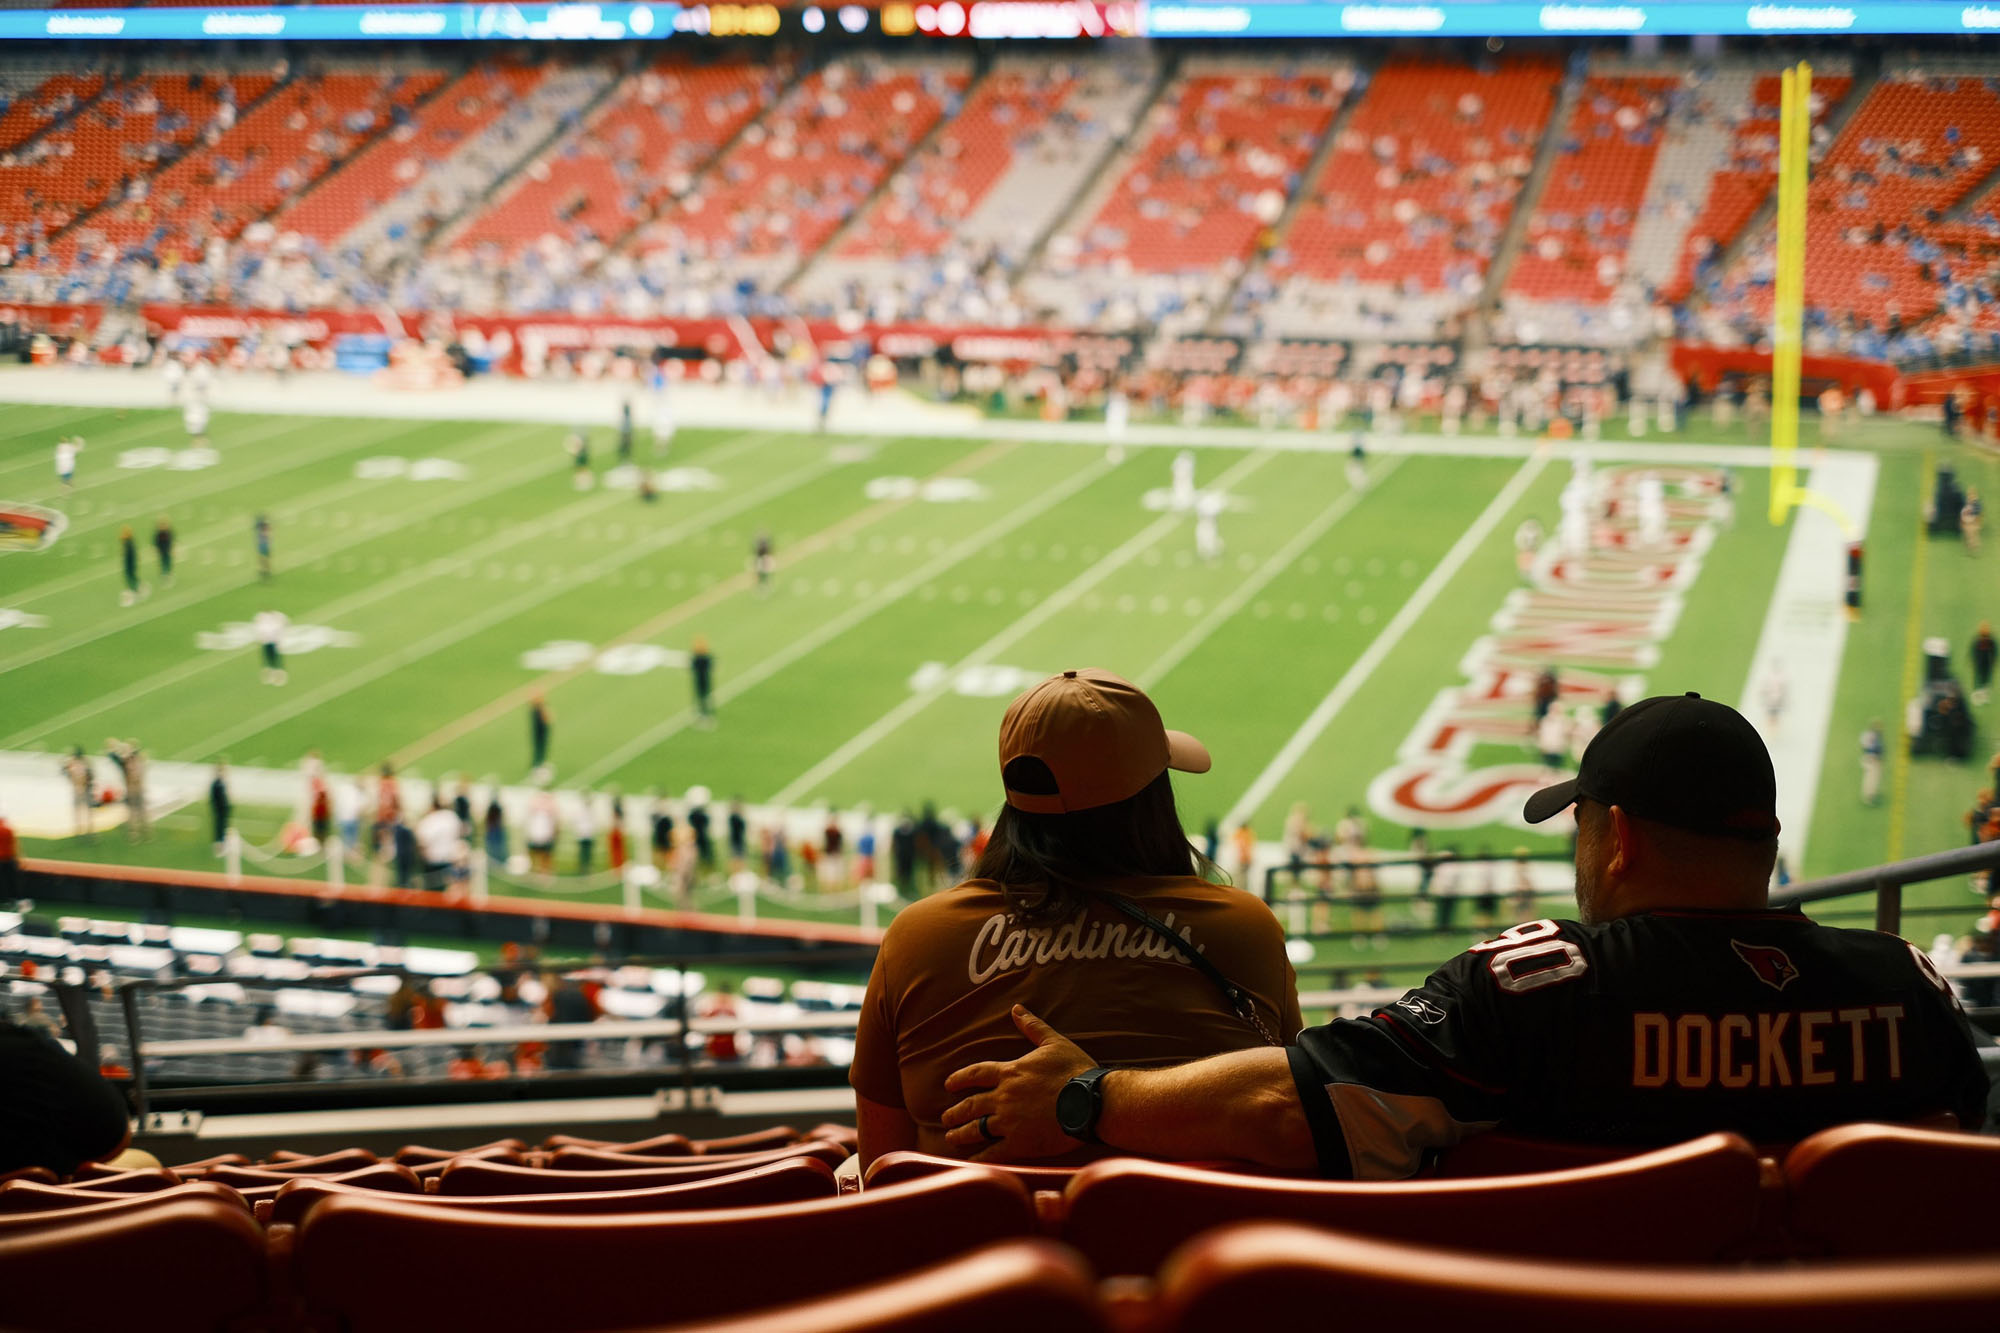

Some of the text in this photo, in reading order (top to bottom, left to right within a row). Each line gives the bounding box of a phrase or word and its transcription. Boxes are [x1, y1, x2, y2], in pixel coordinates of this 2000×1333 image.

[968, 909, 1206, 985] Cardinals
[1468, 918, 1589, 995] 90
[1631, 1003, 1906, 1089] DOCKETT
